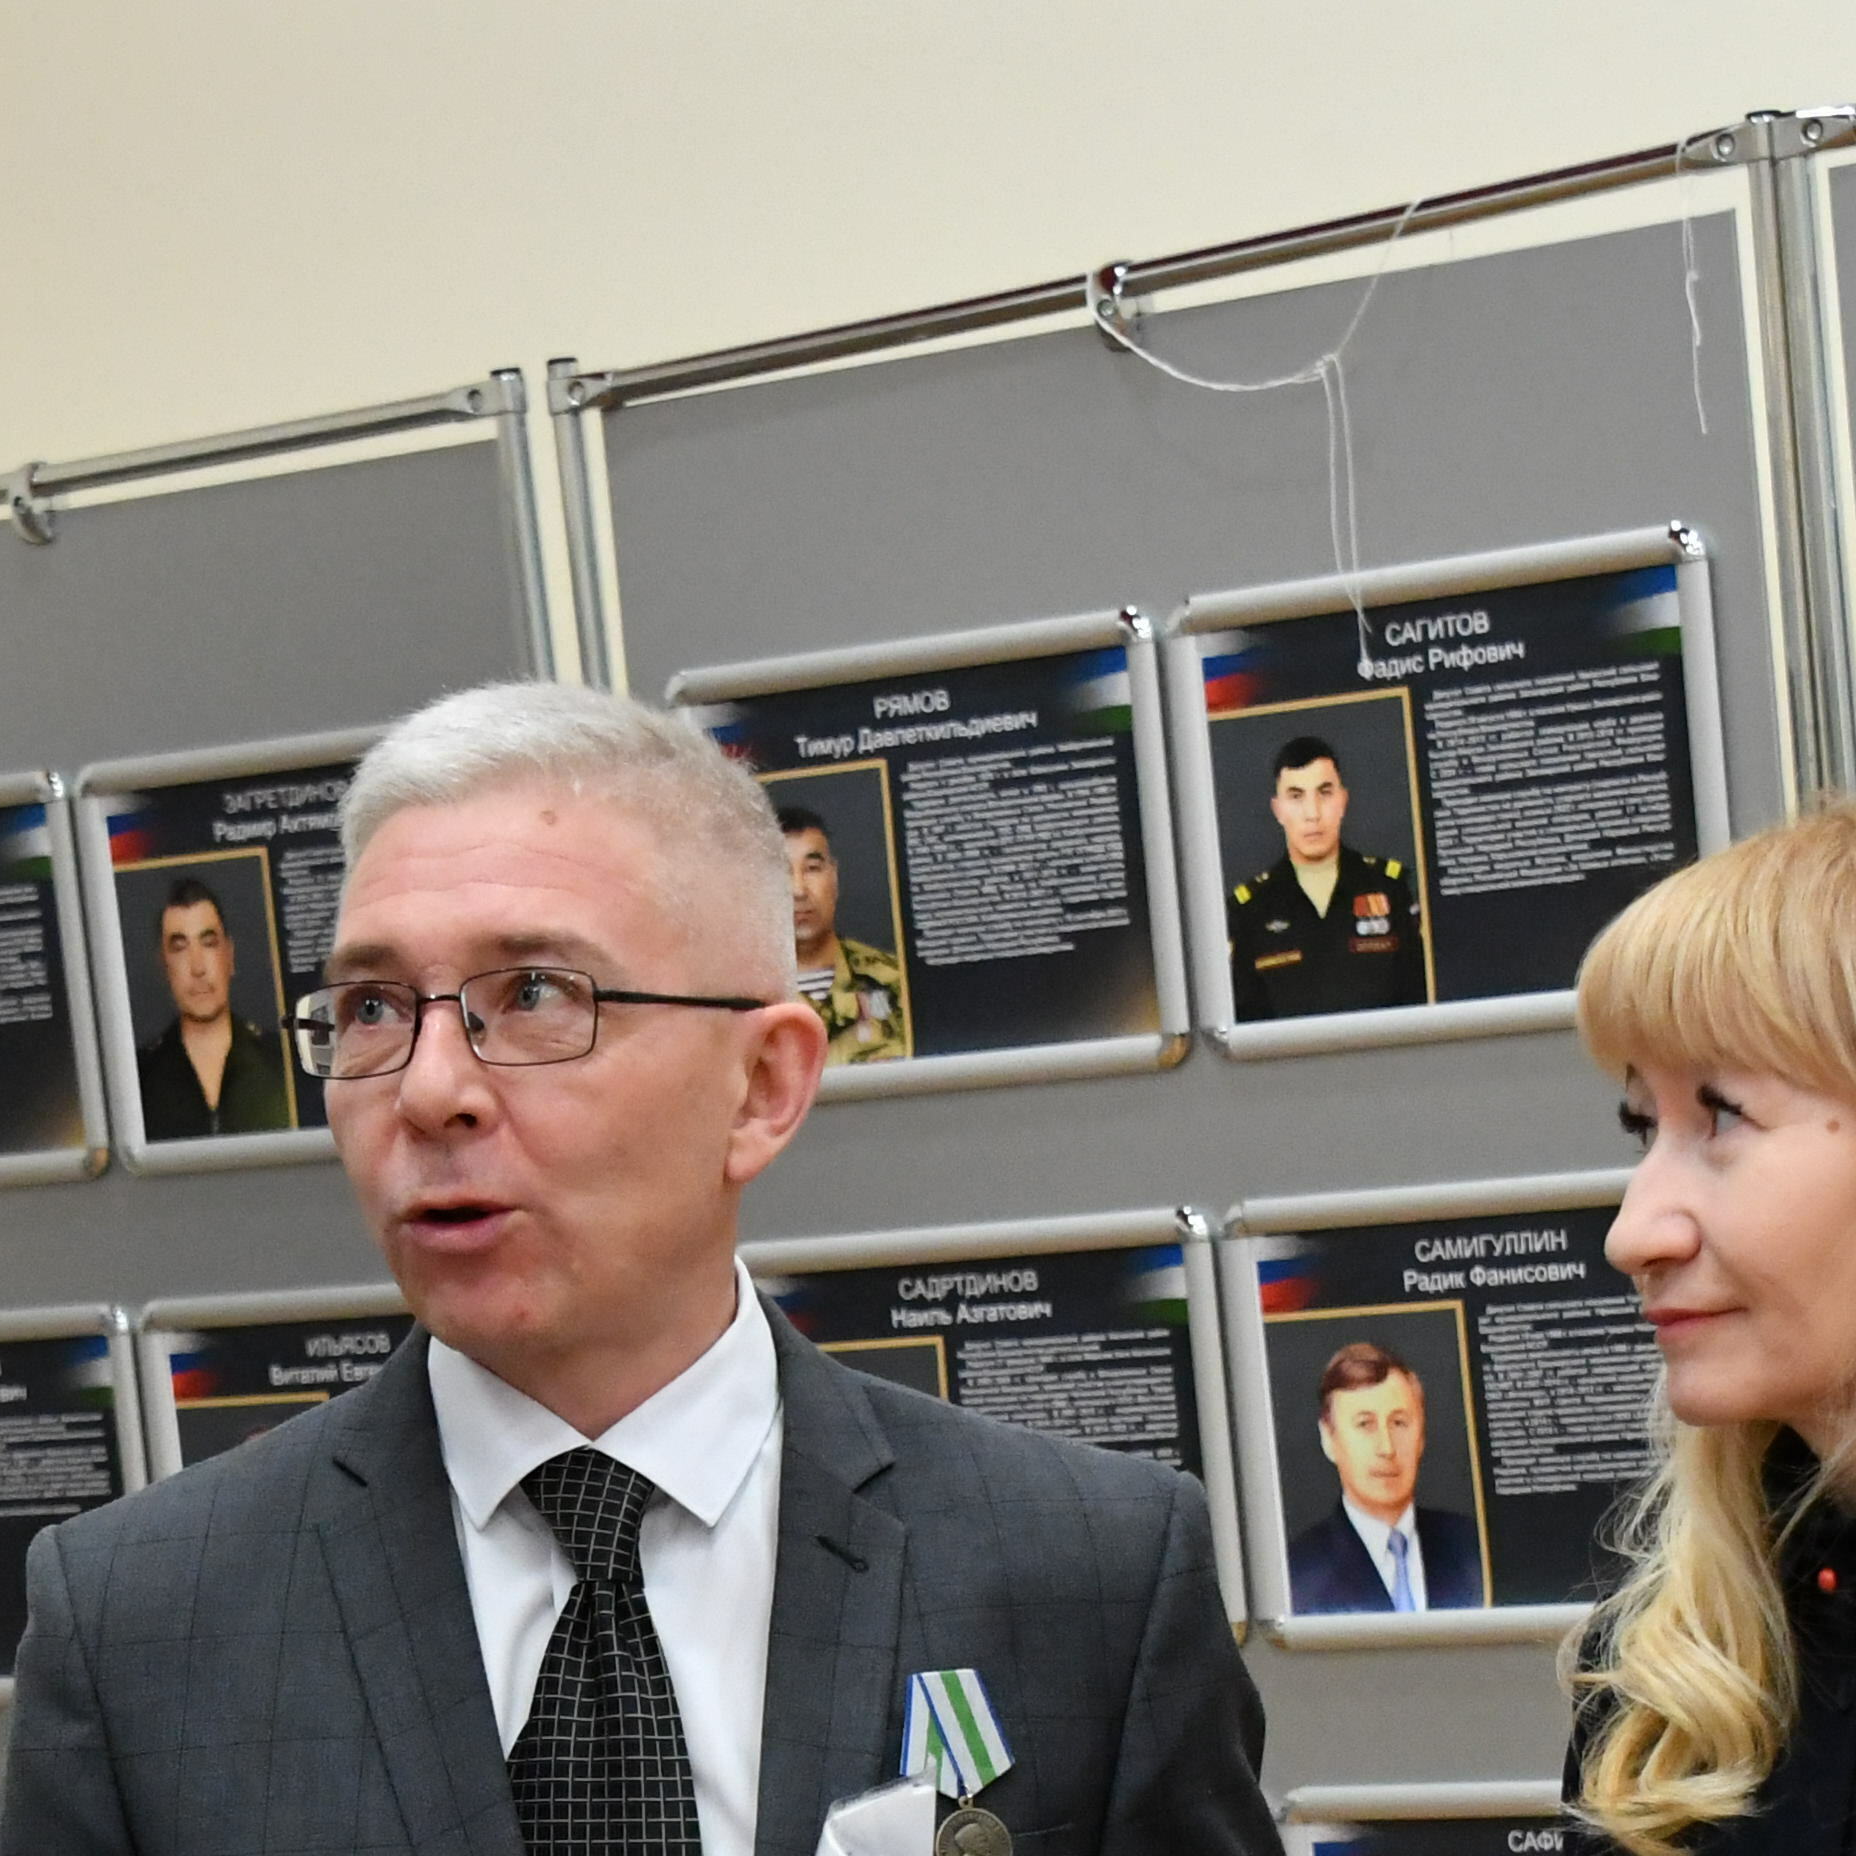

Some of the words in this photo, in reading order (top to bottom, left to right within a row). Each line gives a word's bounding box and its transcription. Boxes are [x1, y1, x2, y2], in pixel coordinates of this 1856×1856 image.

[1385, 609, 1491, 647] САГИТОВ
[1428, 640, 1525, 672] Рифович
[872, 688, 951, 719] РЯМОВ
[794, 733, 854, 759] Тимур
[1414, 1228, 1568, 1263] САМИГУЛЛИН
[897, 1270, 1039, 1302] САДРТДИНОВ
[1402, 1268, 1467, 1294] Радик
[1469, 1261, 1586, 1287] Фанисович
[890, 1306, 953, 1329] Наиль
[956, 1301, 1052, 1325] Азгатович
[1507, 1829, 1564, 1853] САФИ
